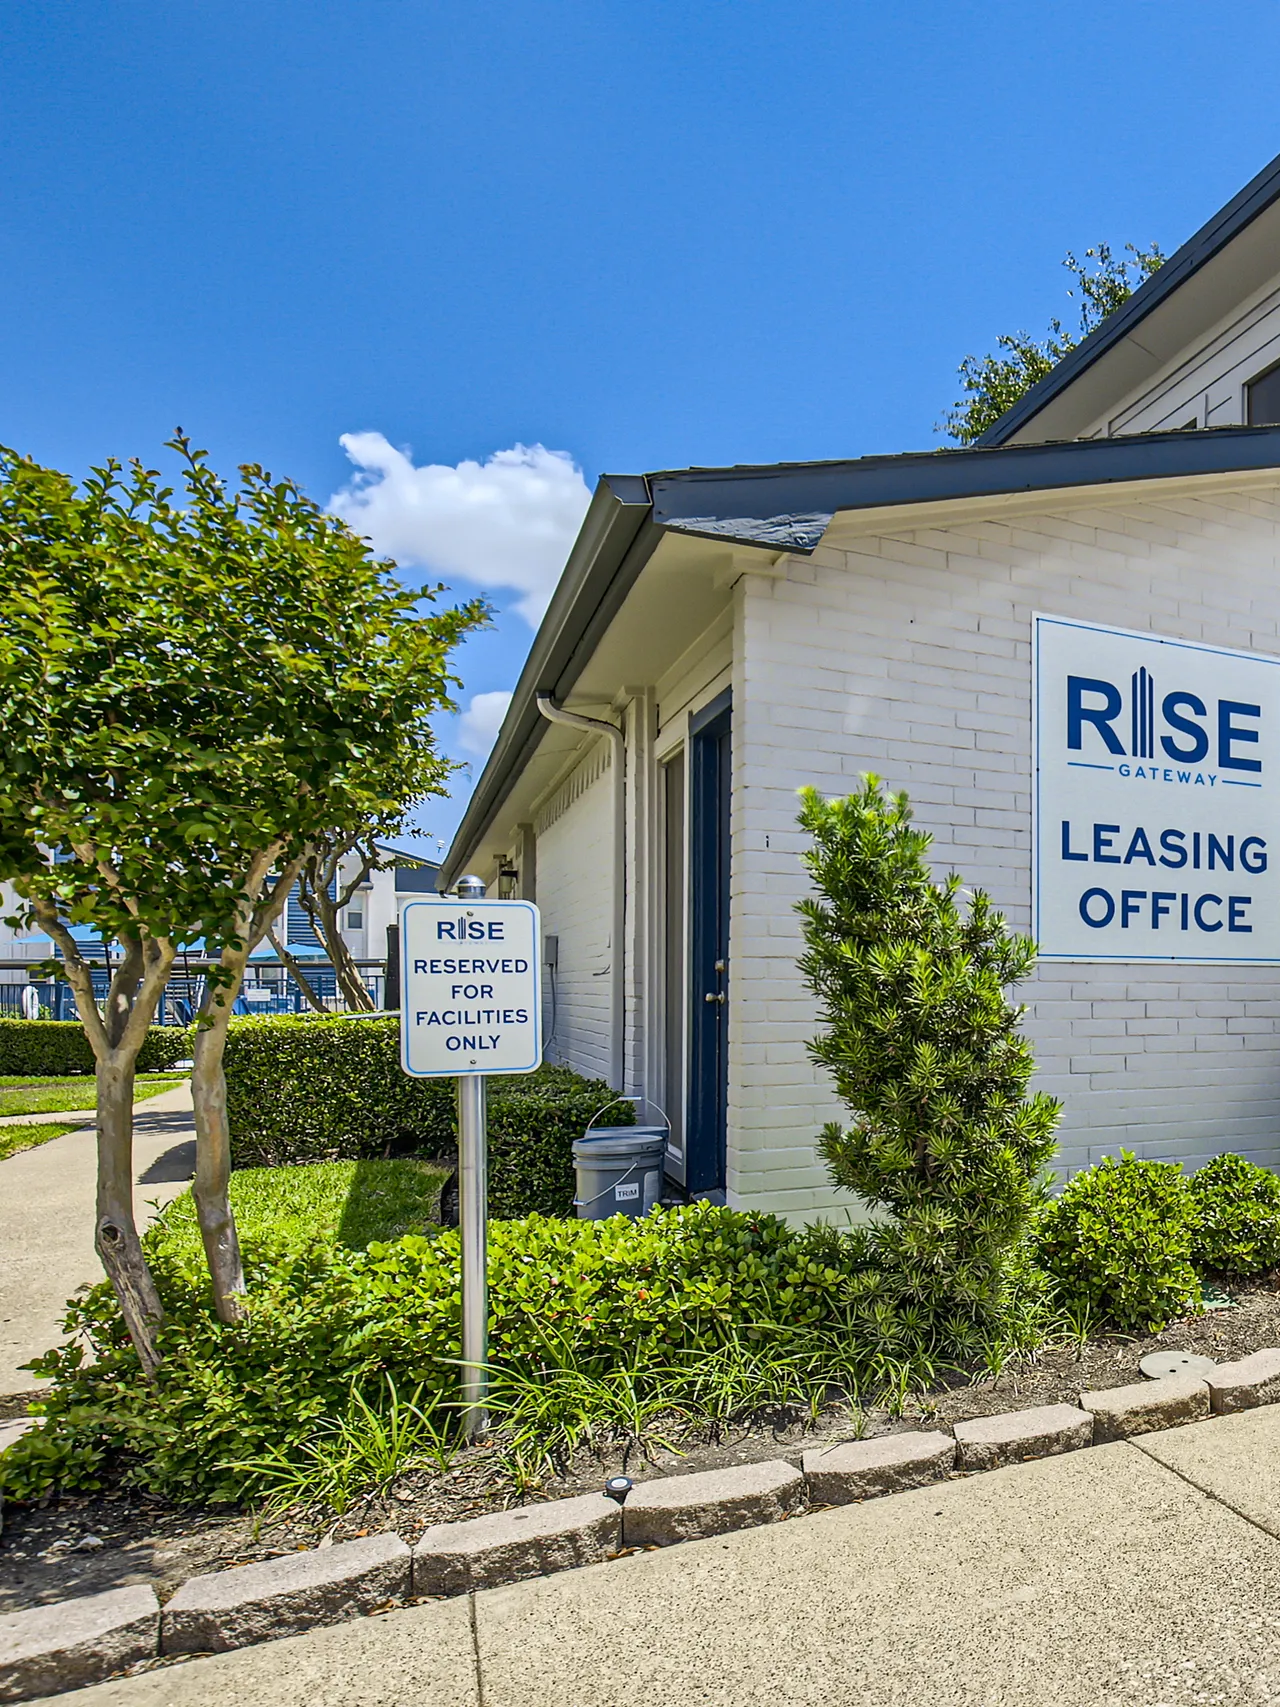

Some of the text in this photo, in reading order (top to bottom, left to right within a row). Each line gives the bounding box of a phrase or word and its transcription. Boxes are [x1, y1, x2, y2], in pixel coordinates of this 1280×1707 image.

[1067, 666, 1262, 772] RISE
[1118, 763, 1217, 787] GATEWAY
[1061, 820, 1268, 874] LEASING
[1079, 887, 1253, 933] OFFICE
[437, 917, 504, 940] RISE
[414, 959, 528, 974] RESERVED
[452, 985, 494, 999] FOR
[416, 1009, 528, 1026] FACILITIES
[446, 1035, 501, 1051] ONLY
[617, 1189, 637, 1198] TRIM
